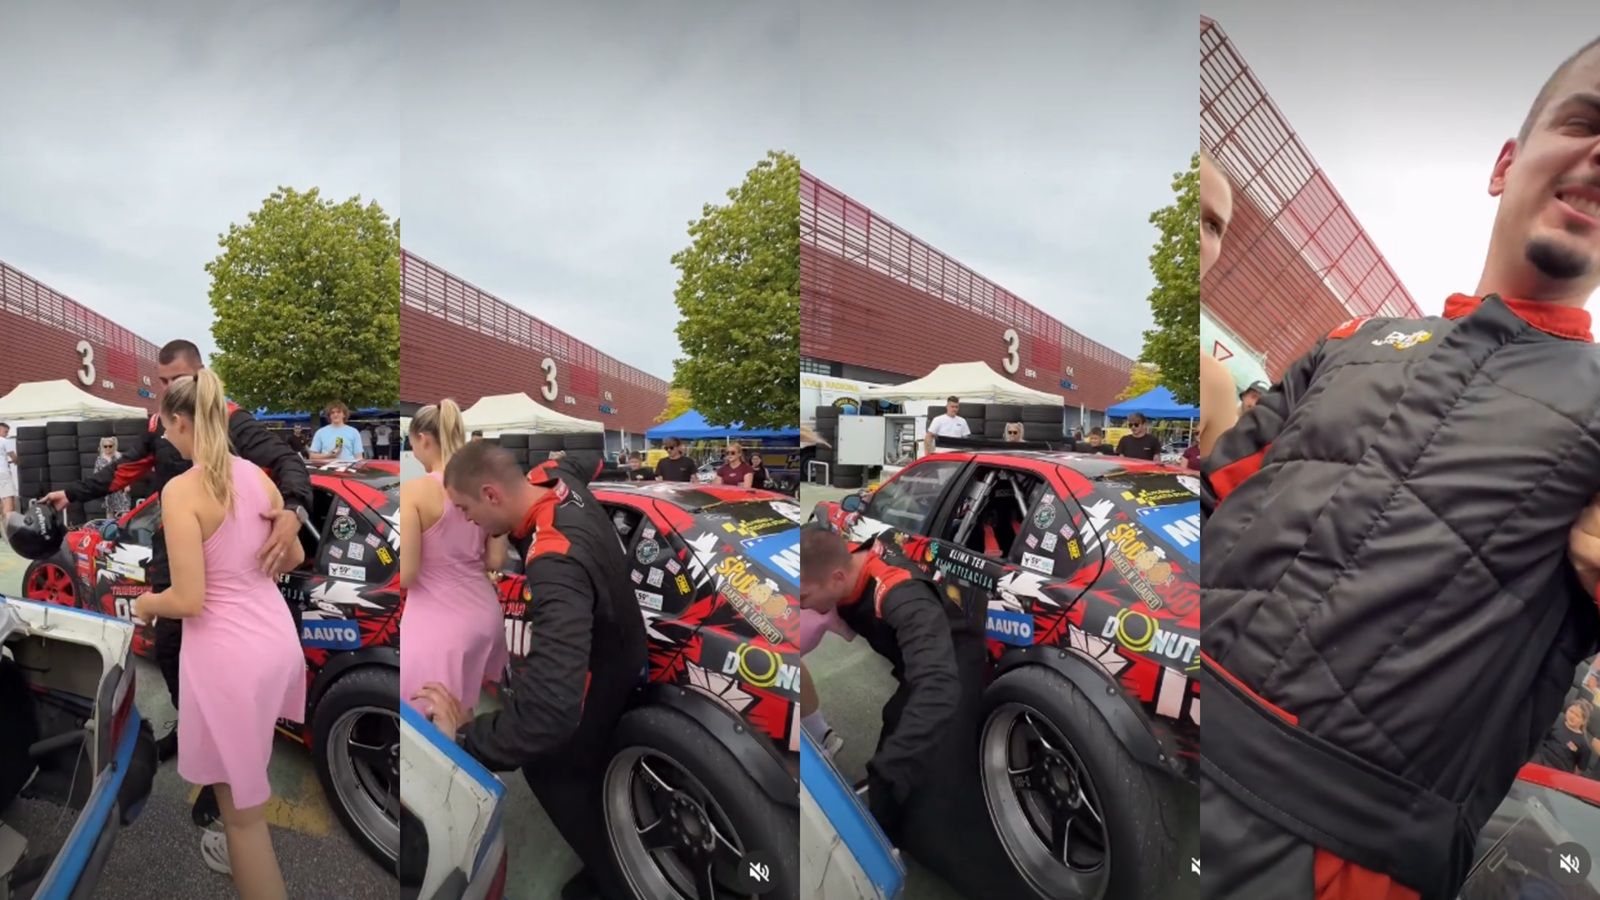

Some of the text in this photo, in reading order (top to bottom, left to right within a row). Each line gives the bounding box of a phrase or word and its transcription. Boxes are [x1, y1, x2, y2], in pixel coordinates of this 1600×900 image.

[76, 340, 96, 386] 3
[1002, 328, 1020, 375] 3
[540, 357, 559, 401] 3
[281, 586, 305, 602] CIJA
[302, 627, 357, 642] AAUTO
[986, 617, 1031, 638] AAUTO
